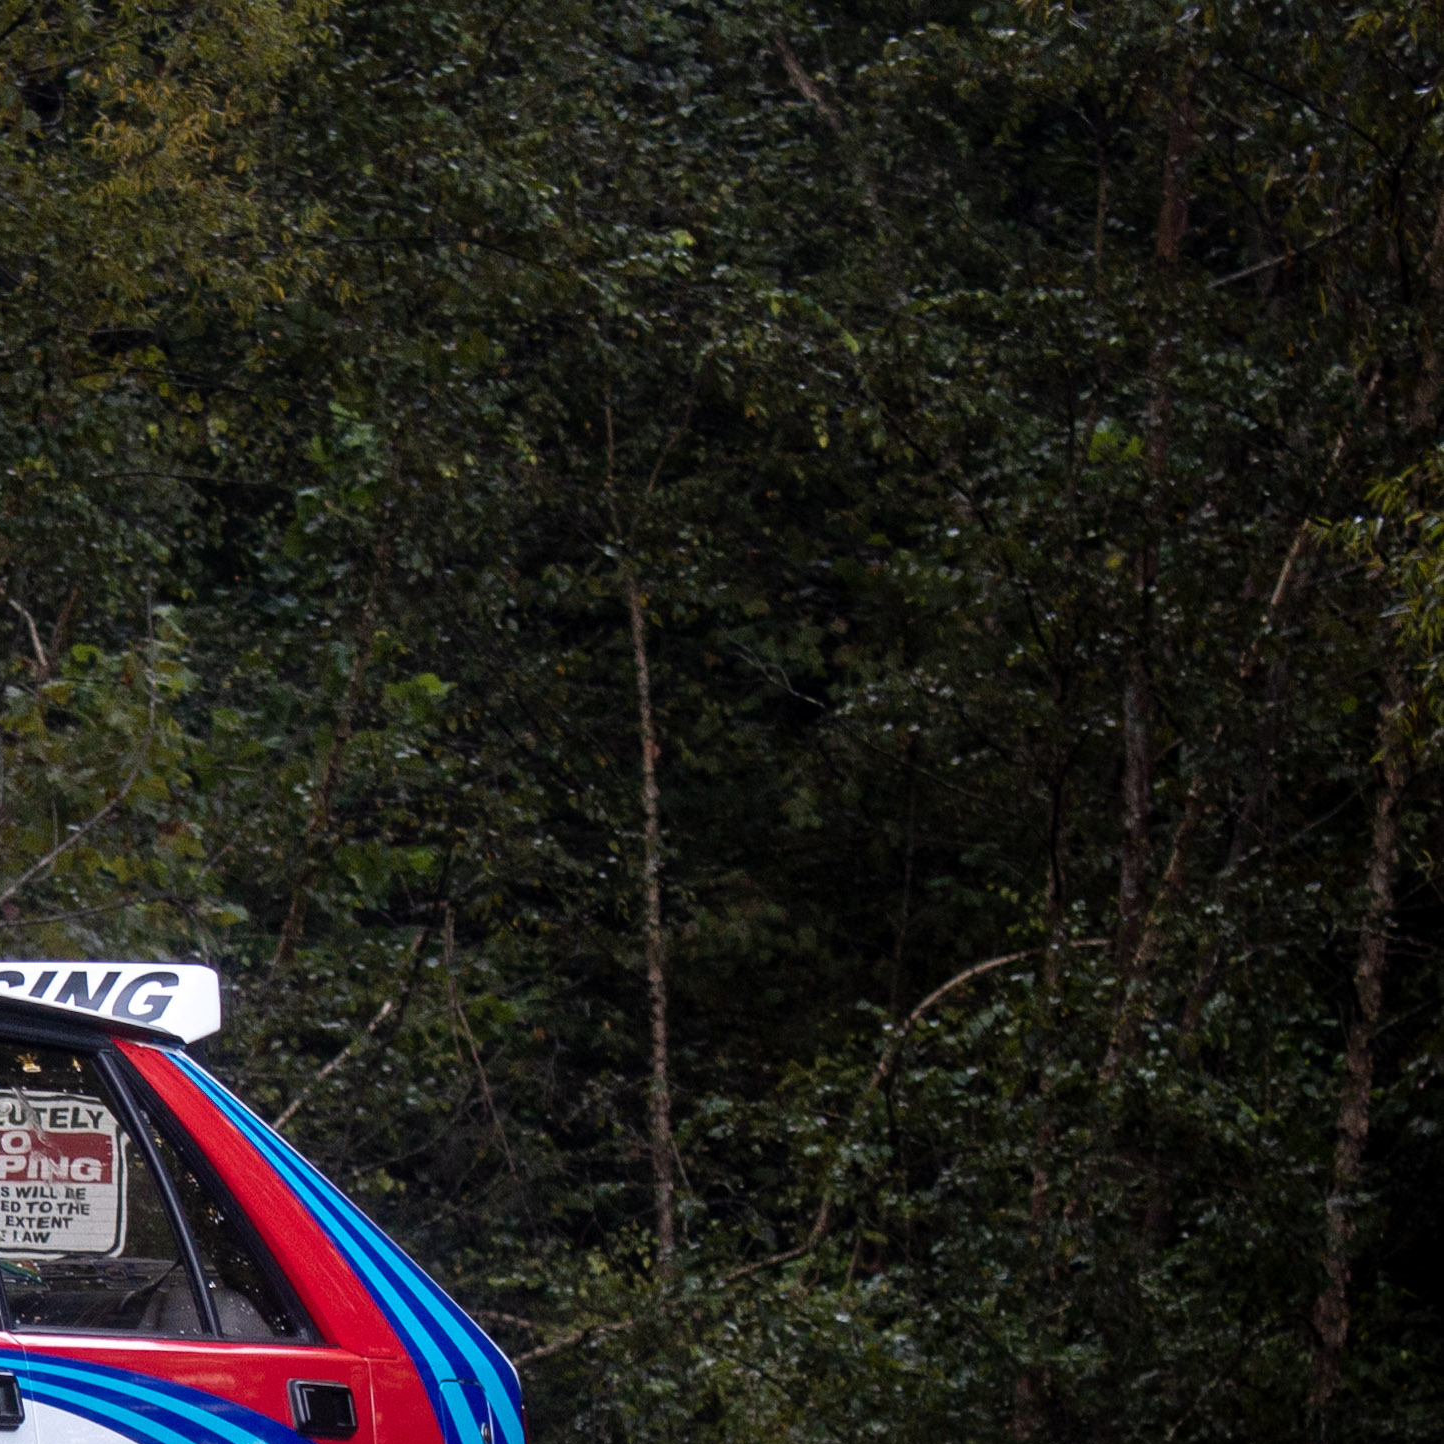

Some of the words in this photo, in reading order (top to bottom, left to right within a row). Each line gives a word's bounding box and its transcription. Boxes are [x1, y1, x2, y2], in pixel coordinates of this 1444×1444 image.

[15, 1186, 58, 1199] WILL
[65, 1187, 86, 1200] BE
[26, 1202, 53, 1214] TO
[57, 1202, 90, 1216] THE
[5, 1215, 73, 1229] EXTENT
[13, 1231, 51, 1243] LAW
